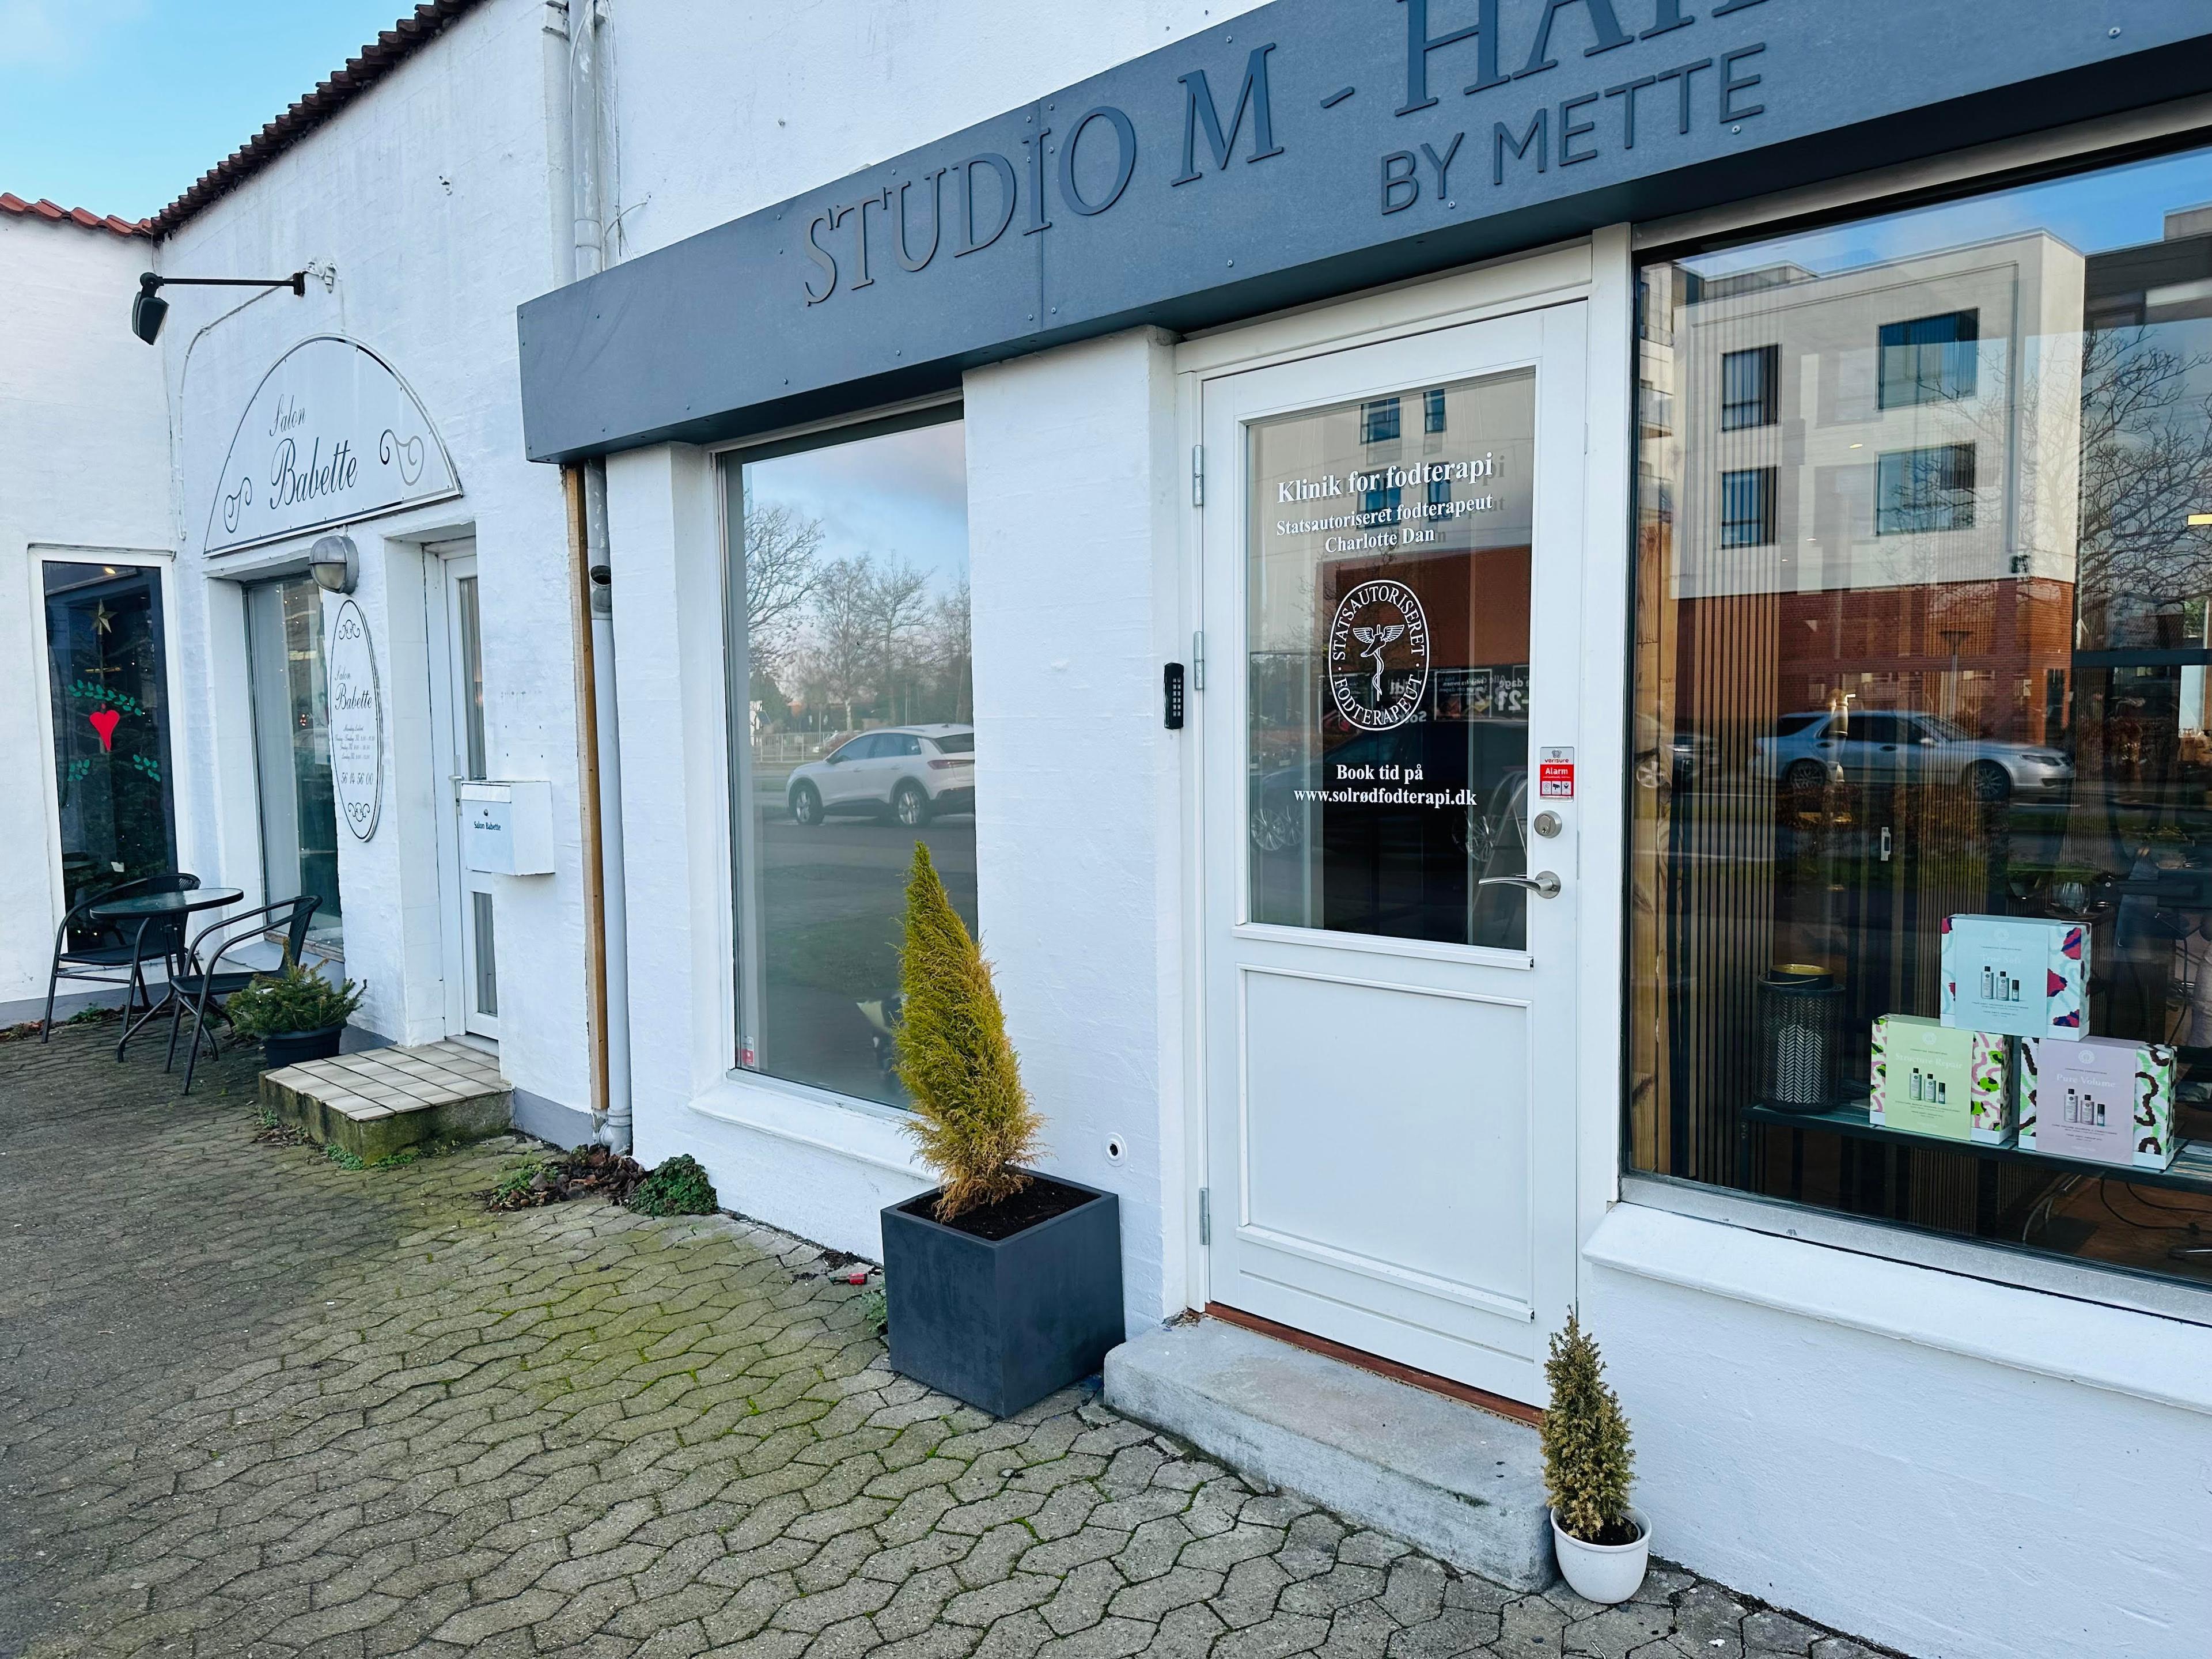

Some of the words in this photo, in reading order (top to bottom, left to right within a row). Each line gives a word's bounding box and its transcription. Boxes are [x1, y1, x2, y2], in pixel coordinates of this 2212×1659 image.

[1381, 132, 1464, 215] BY
[1493, 42, 1766, 185] METTE
[805, 105, 1137, 306] STUDIO
[1171, 43, 1285, 187] M
[269, 394, 306, 437] Salon
[270, 436, 358, 510] Babette
[1277, 474, 1342, 504] Klinik
[1348, 470, 1380, 494] for
[1386, 452, 1494, 488] fodterapi
[1276, 508, 1392, 536] Statsautoriseret
[1396, 494, 1493, 521] fodterapeut
[1325, 533, 1397, 554] Charlotte
[1402, 527, 1435, 545] Dan
[1332, 585, 1425, 661] STATSAUTORISERET
[335, 665, 351, 681] Salon
[335, 683, 373, 710] Babette
[1334, 674, 1422, 725] FODTERAPEUT
[366, 773, 373, 785] 00
[1336, 764, 1376, 781] Book
[1379, 764, 1400, 780] tid
[1404, 763, 1423, 784] på
[1293, 787, 1478, 809] www.solrødfodterapi.dk
[474, 821, 484, 830] Salon
[486, 822, 501, 831] Babette
[1895, 1053, 1934, 1064] Structure
[1936, 1057, 1963, 1069] Repair
[2056, 1073, 2078, 1083] Pure
[2081, 1076, 2116, 1088] Volume
